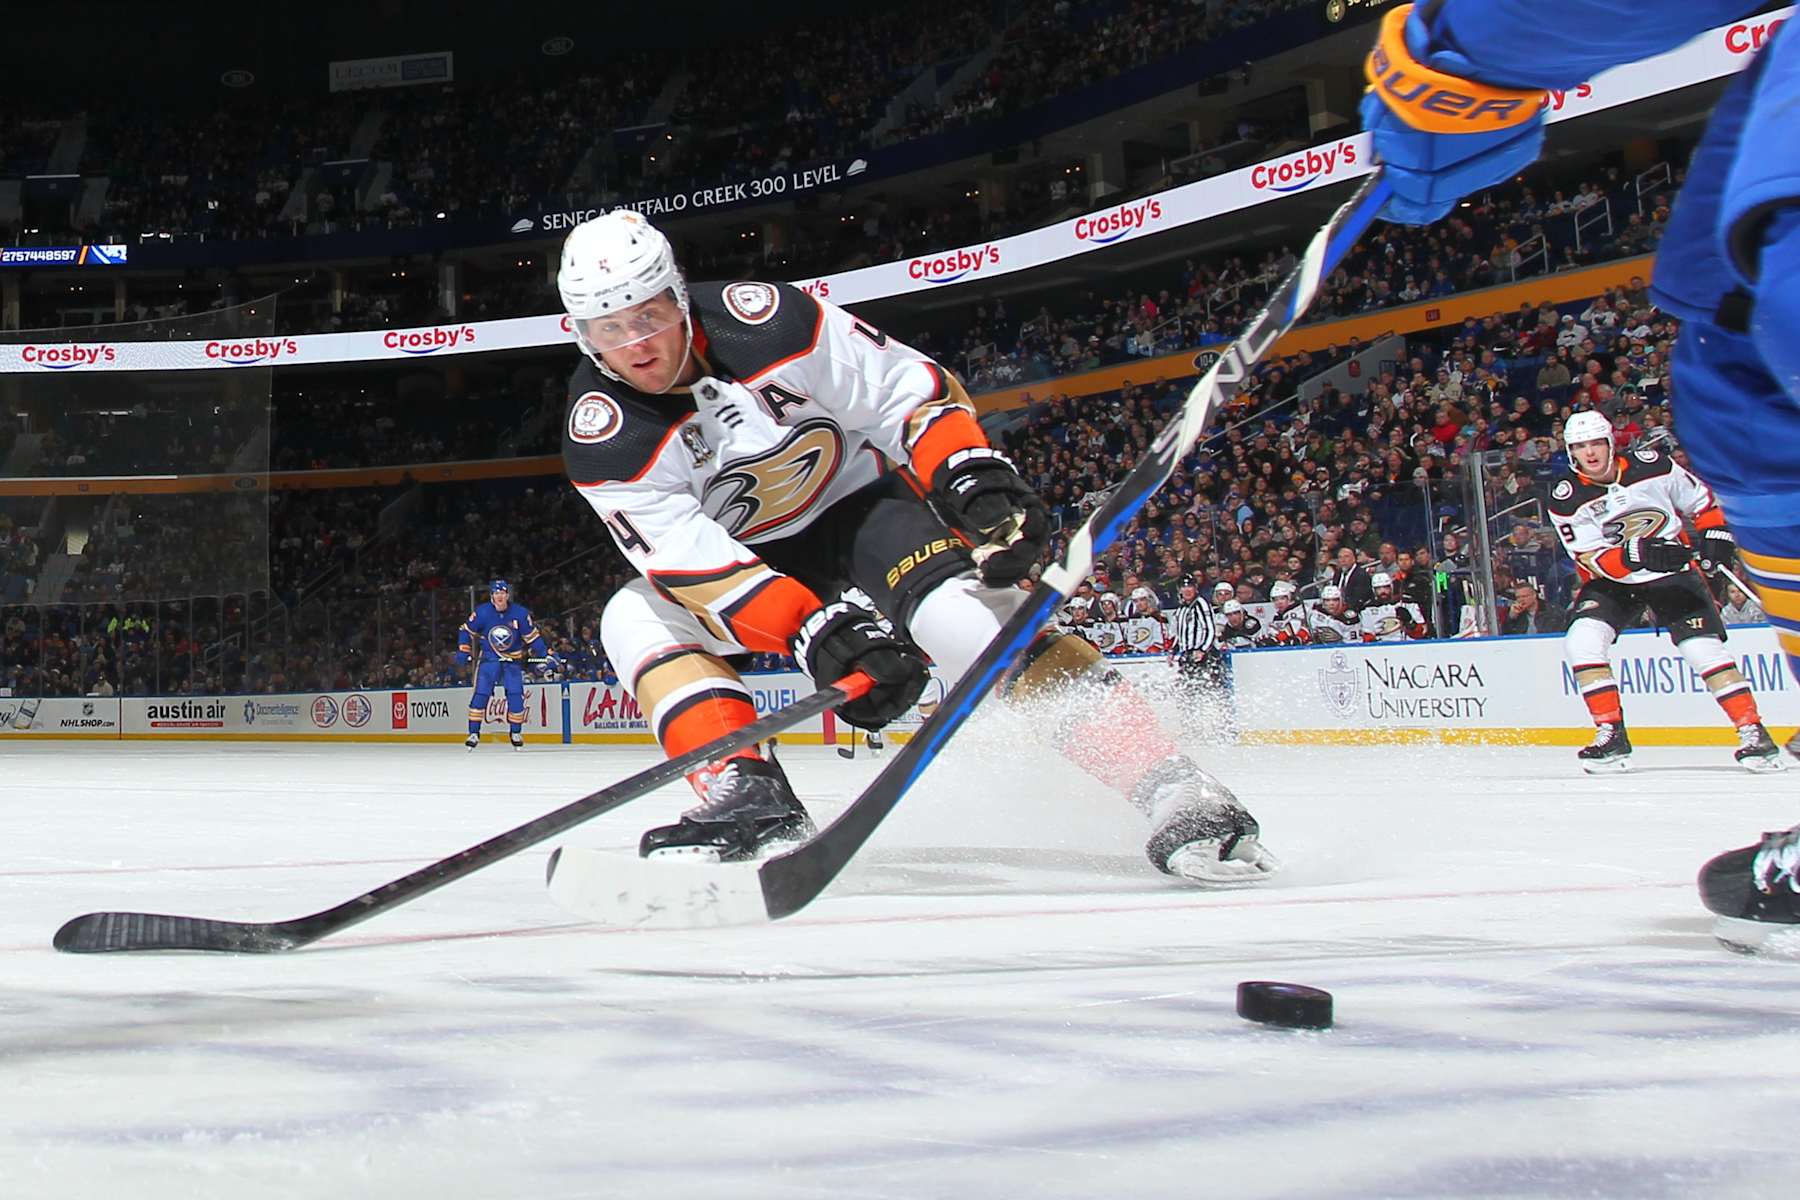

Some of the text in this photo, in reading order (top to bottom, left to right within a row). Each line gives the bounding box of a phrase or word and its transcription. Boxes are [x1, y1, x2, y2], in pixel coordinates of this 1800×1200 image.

[1251, 142, 1356, 189] Crosby's
[614, 194, 687, 216] FFALO
[693, 183, 747, 206] CREEK
[750, 176, 786, 197] 300
[793, 164, 841, 190] LEVEL
[1075, 198, 1162, 240] Crosby's
[2, 250, 76, 262] 2757448597
[908, 245, 1000, 279] Crosby's
[205, 338, 297, 358] Crosby's
[384, 326, 475, 349] Crosby's
[22, 345, 115, 364] Crosby's
[755, 381, 811, 422] A
[886, 537, 965, 590] BAUER
[1365, 658, 1484, 690] NIAGARA
[1620, 653, 1784, 694] AMSTEAM
[147, 700, 226, 719] austin air
[411, 701, 449, 718] TOYOTA
[583, 687, 617, 727] LA
[1367, 692, 1488, 719] UNIVERSITY
